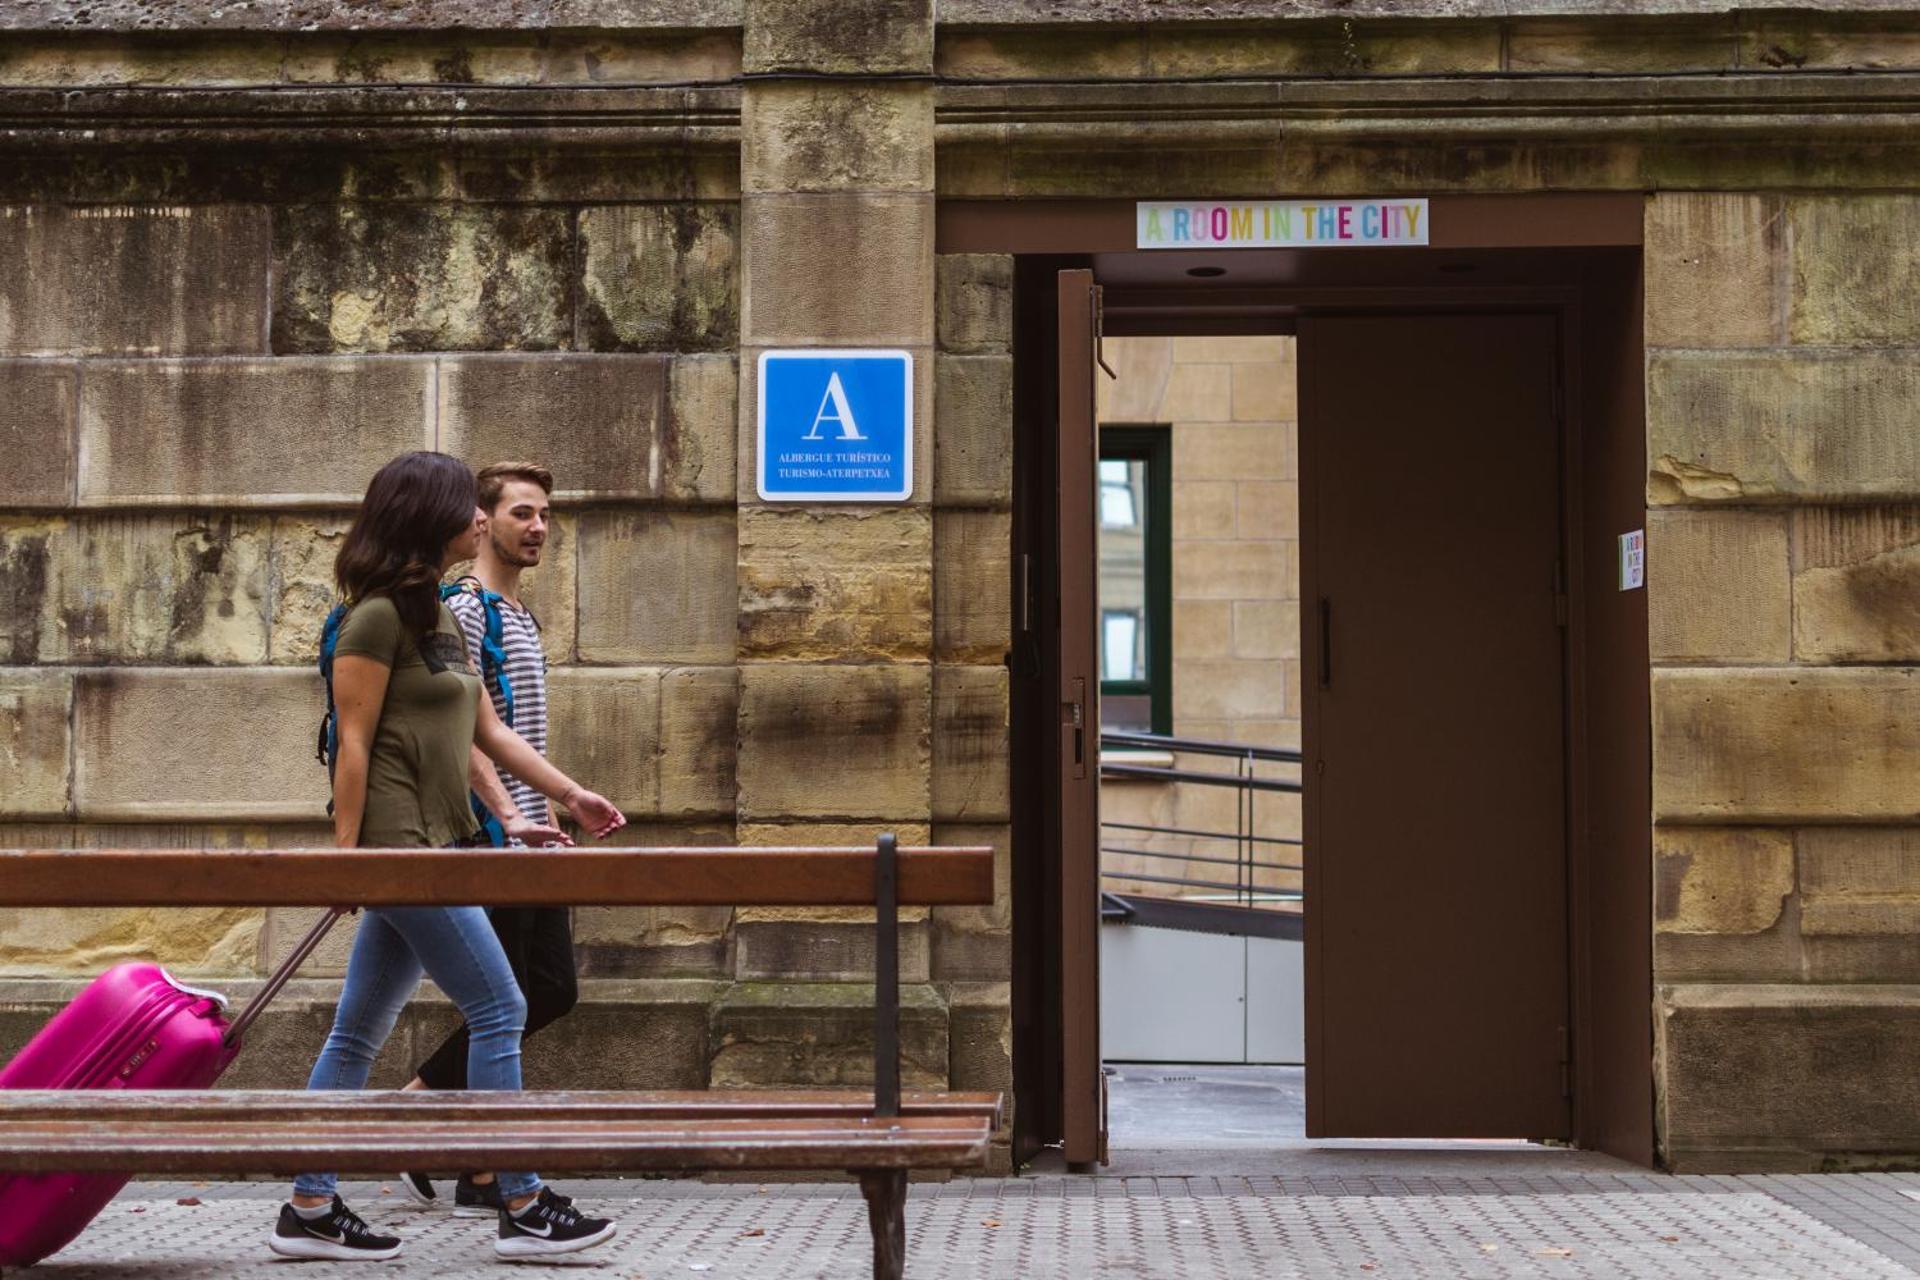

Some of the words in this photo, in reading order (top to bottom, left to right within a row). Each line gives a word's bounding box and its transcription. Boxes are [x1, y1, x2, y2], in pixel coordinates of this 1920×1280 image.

[1146, 208, 1162, 240] A
[1173, 207, 1253, 240] ROOM
[1264, 206, 1291, 240] IN
[1302, 206, 1353, 240] THE
[1362, 205, 1421, 239] CITY
[801, 371, 868, 440] A
[779, 452, 833, 463] ALBERGUE
[835, 451, 891, 463] TURÍSTICO
[778, 468, 890, 479] TURISMO-ATERPETXEA
